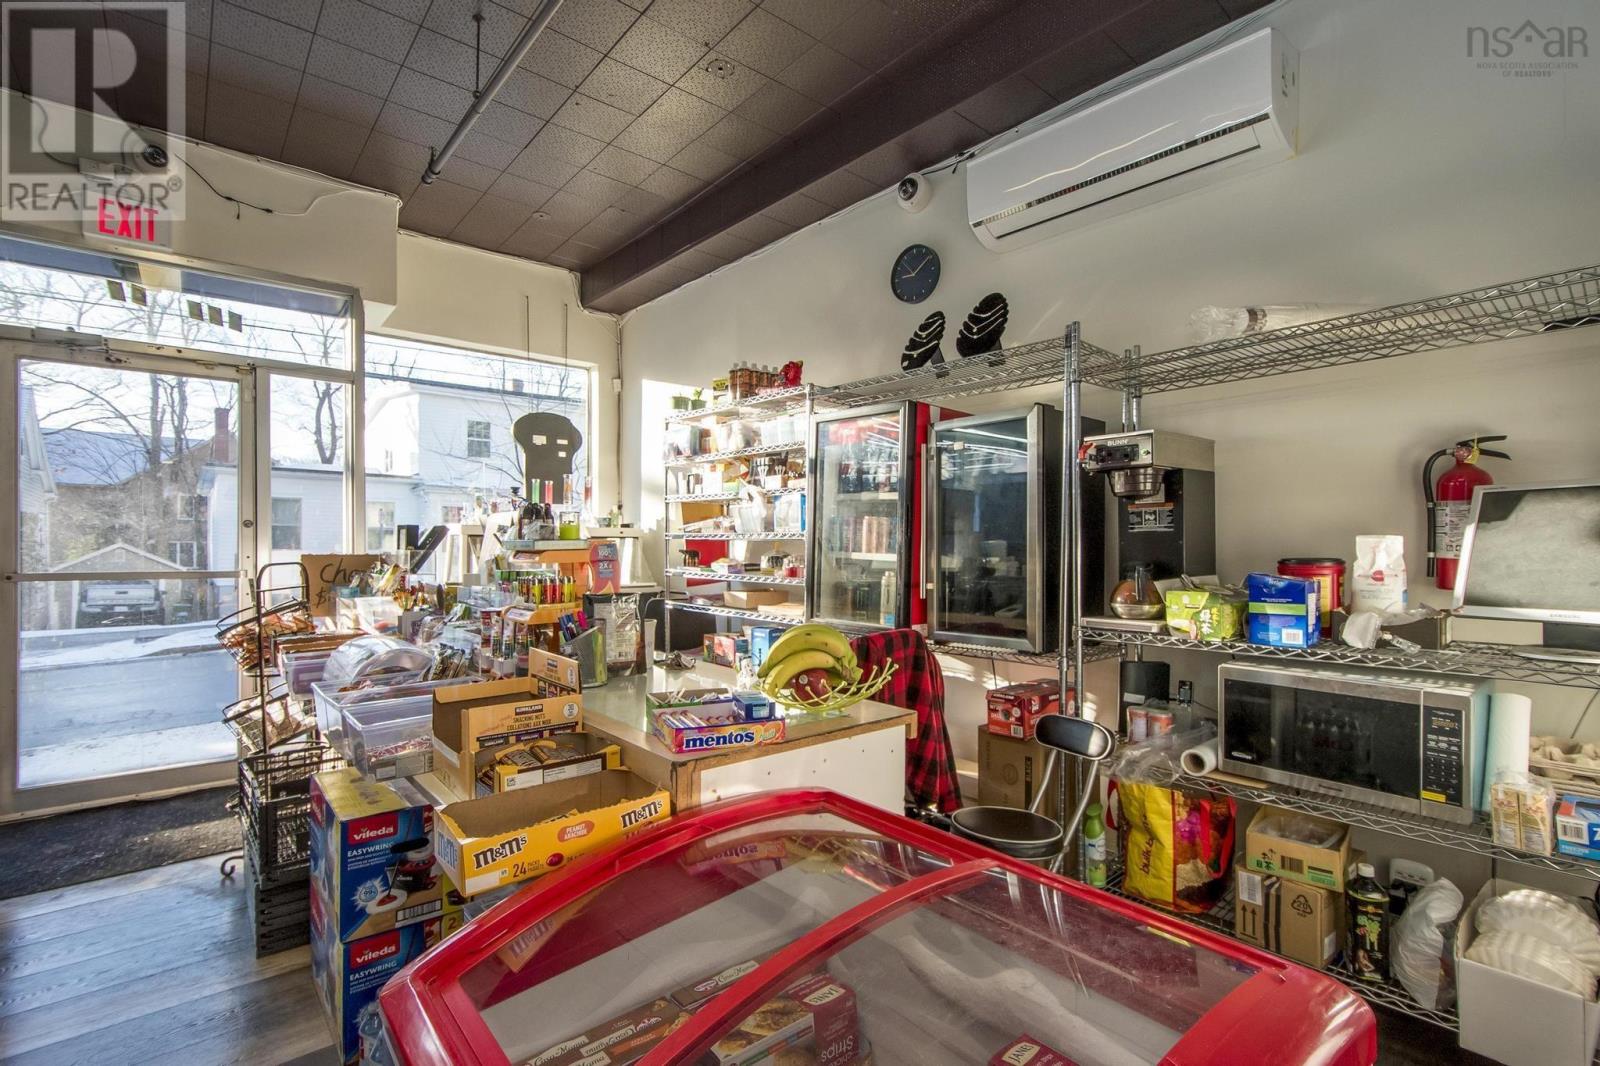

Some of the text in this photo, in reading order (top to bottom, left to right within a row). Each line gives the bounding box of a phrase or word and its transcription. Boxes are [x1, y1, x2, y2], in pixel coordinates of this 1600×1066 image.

[98, 197, 159, 242] EXIT
[684, 731, 755, 749] mentos
[353, 825, 394, 841] vileda
[513, 861, 528, 878] 24
[447, 916, 457, 930] 2
[356, 944, 397, 963] vileda
[820, 1035, 854, 1063] Strips
